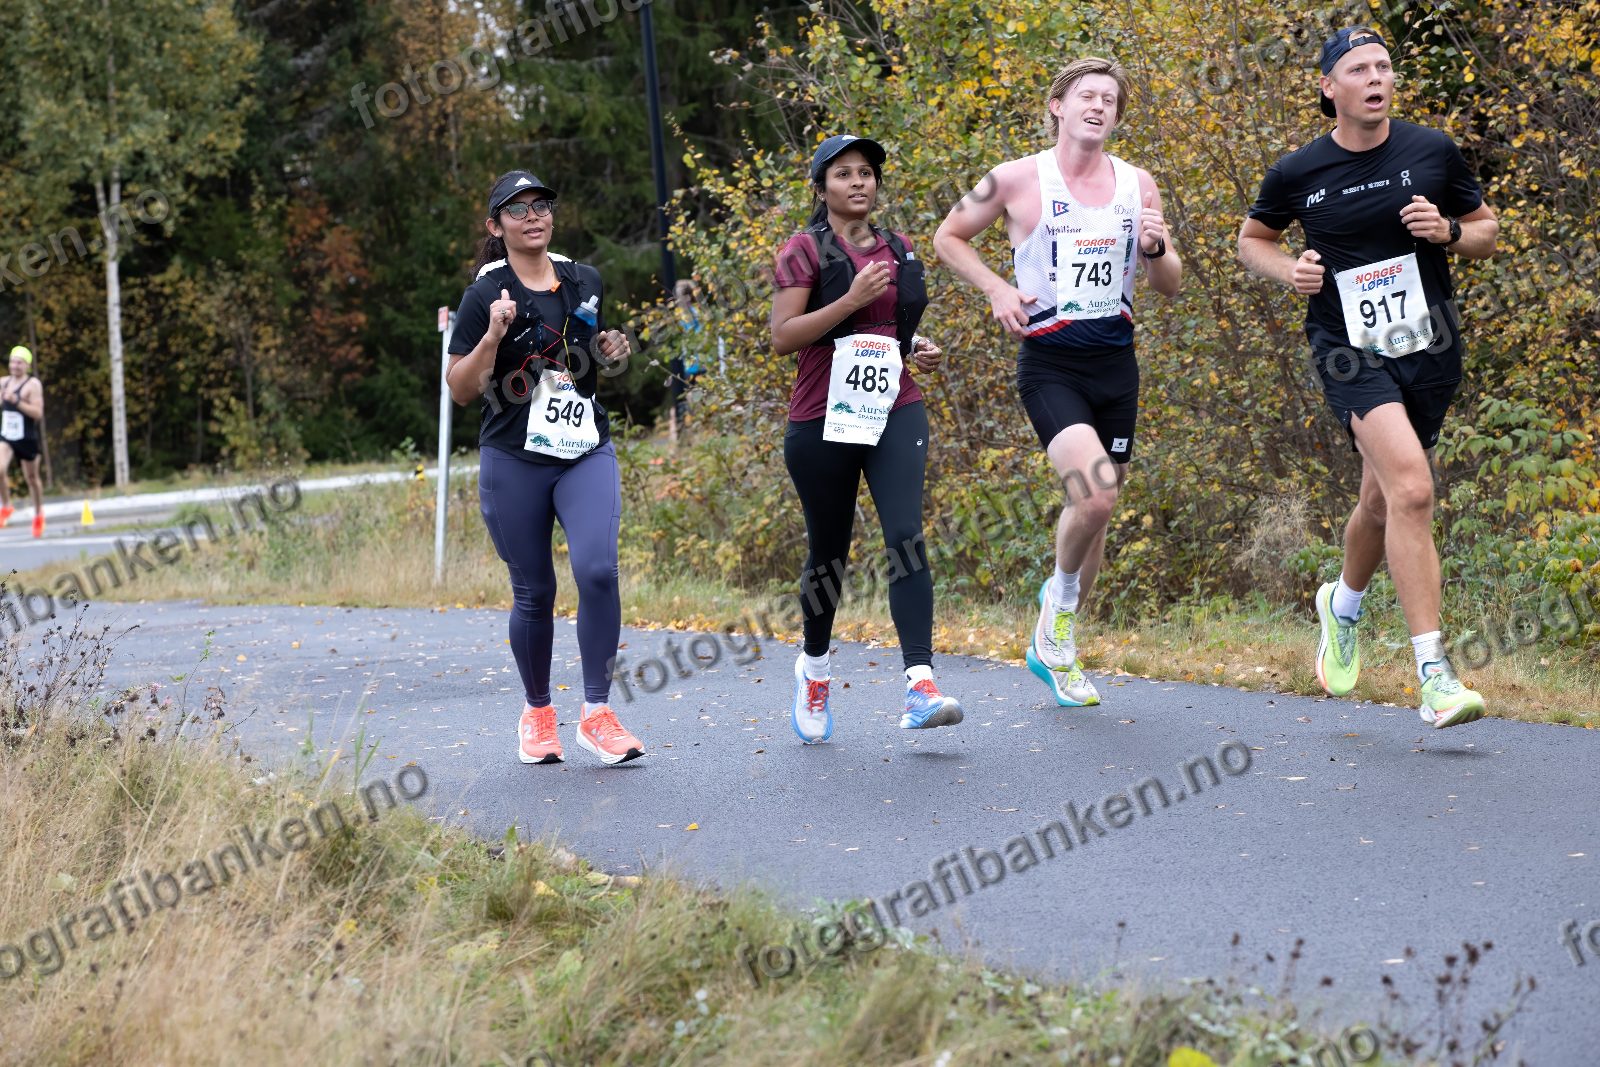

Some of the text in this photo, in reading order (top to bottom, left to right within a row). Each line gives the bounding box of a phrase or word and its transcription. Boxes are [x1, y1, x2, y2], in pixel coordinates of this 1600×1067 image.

[1074, 238, 1117, 248] NORGES
[1078, 246, 1110, 255] LØPET
[1072, 261, 1112, 288] 743
[1354, 264, 1403, 284] NORGES
[1361, 275, 1397, 293] LØPET
[1359, 289, 1407, 329] 917
[851, 340, 891, 352] NORGES
[1387, 326, 1430, 346] Aurskog
[854, 348, 887, 359] LØPET
[845, 364, 889, 394] 485
[544, 396, 585, 428] 549
